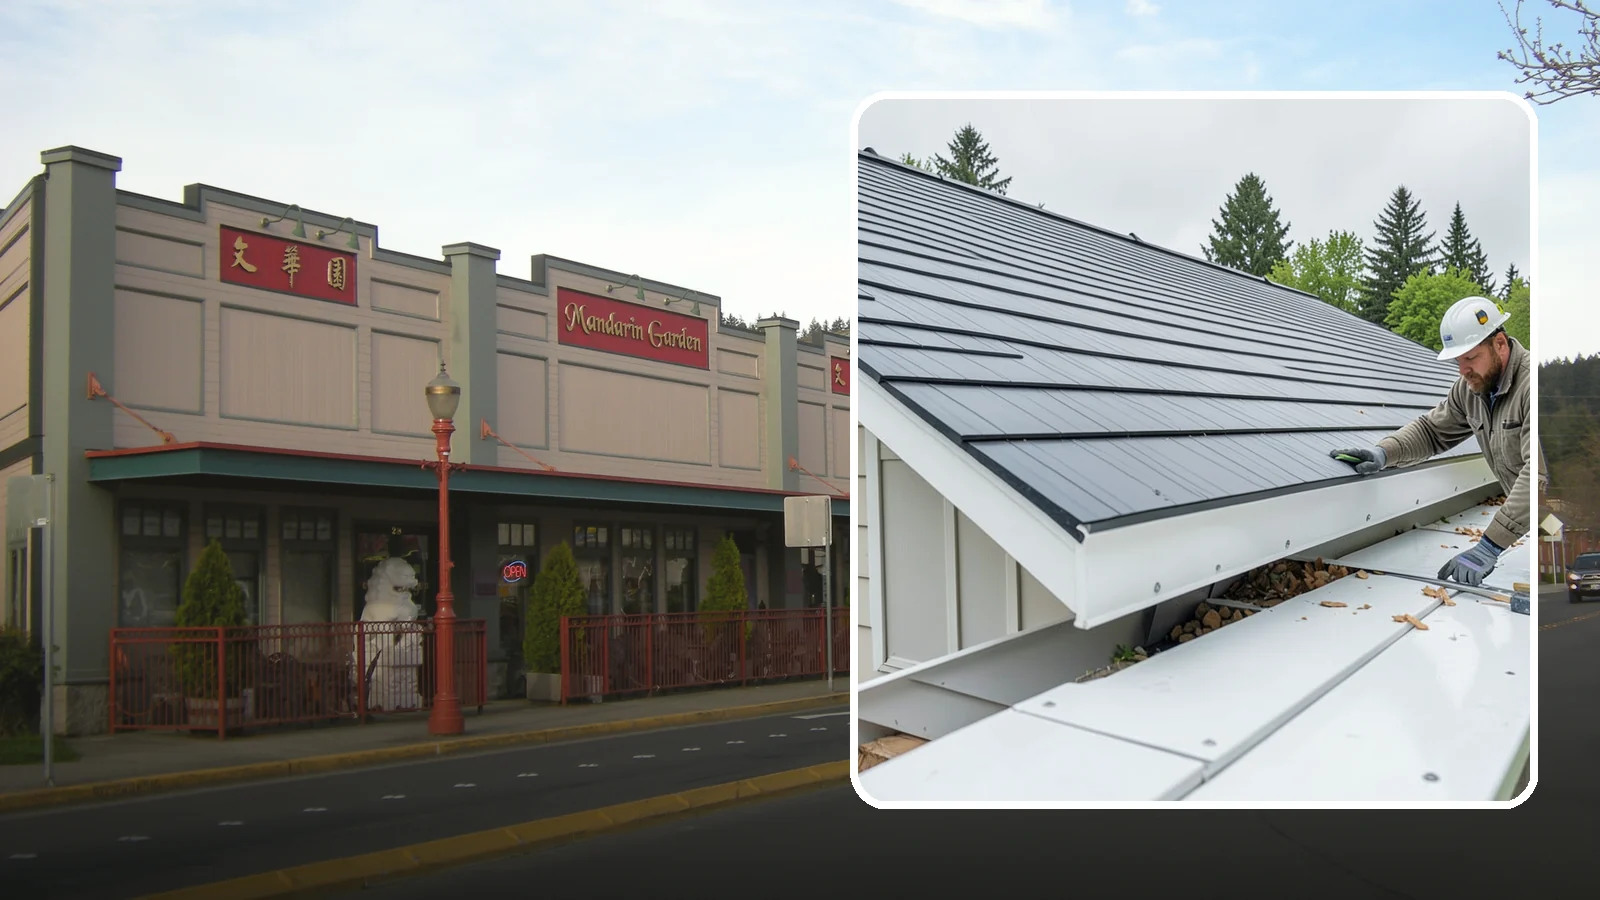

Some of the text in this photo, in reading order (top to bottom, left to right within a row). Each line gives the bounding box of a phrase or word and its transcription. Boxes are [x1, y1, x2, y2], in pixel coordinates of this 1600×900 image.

[231, 236, 346, 290] 文華園
[564, 302, 701, 352] Mandarin Garden
[503, 564, 527, 578] OPEN
